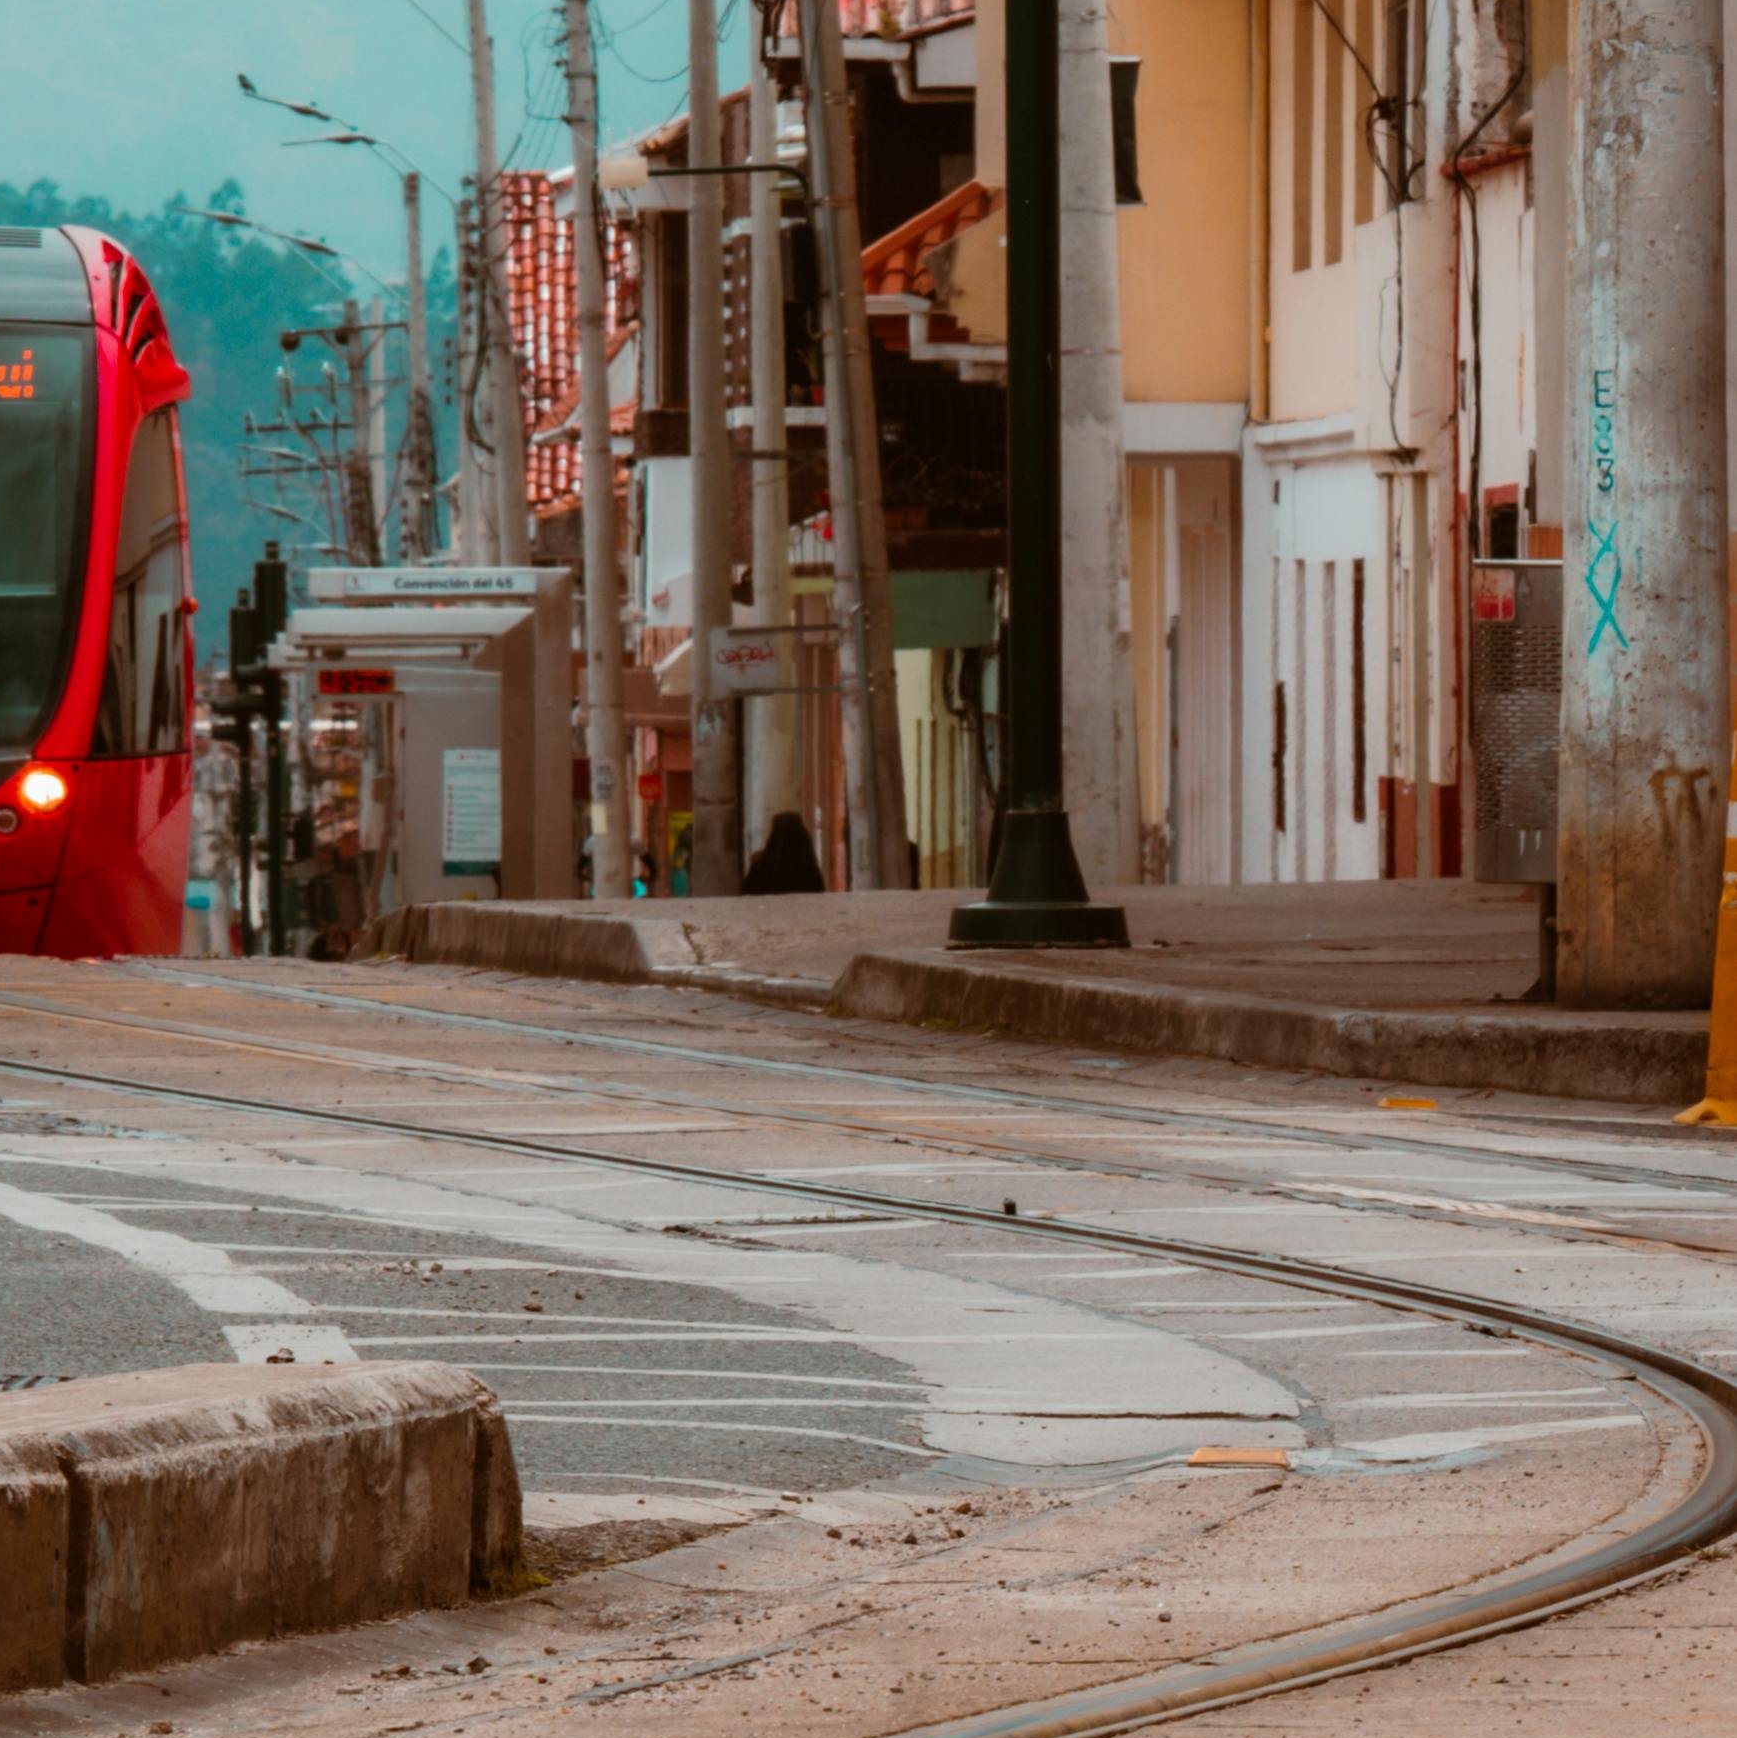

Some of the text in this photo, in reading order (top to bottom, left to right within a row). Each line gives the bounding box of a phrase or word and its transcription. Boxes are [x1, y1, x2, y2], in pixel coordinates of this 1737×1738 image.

[394, 575, 513, 590] Convención del 45
